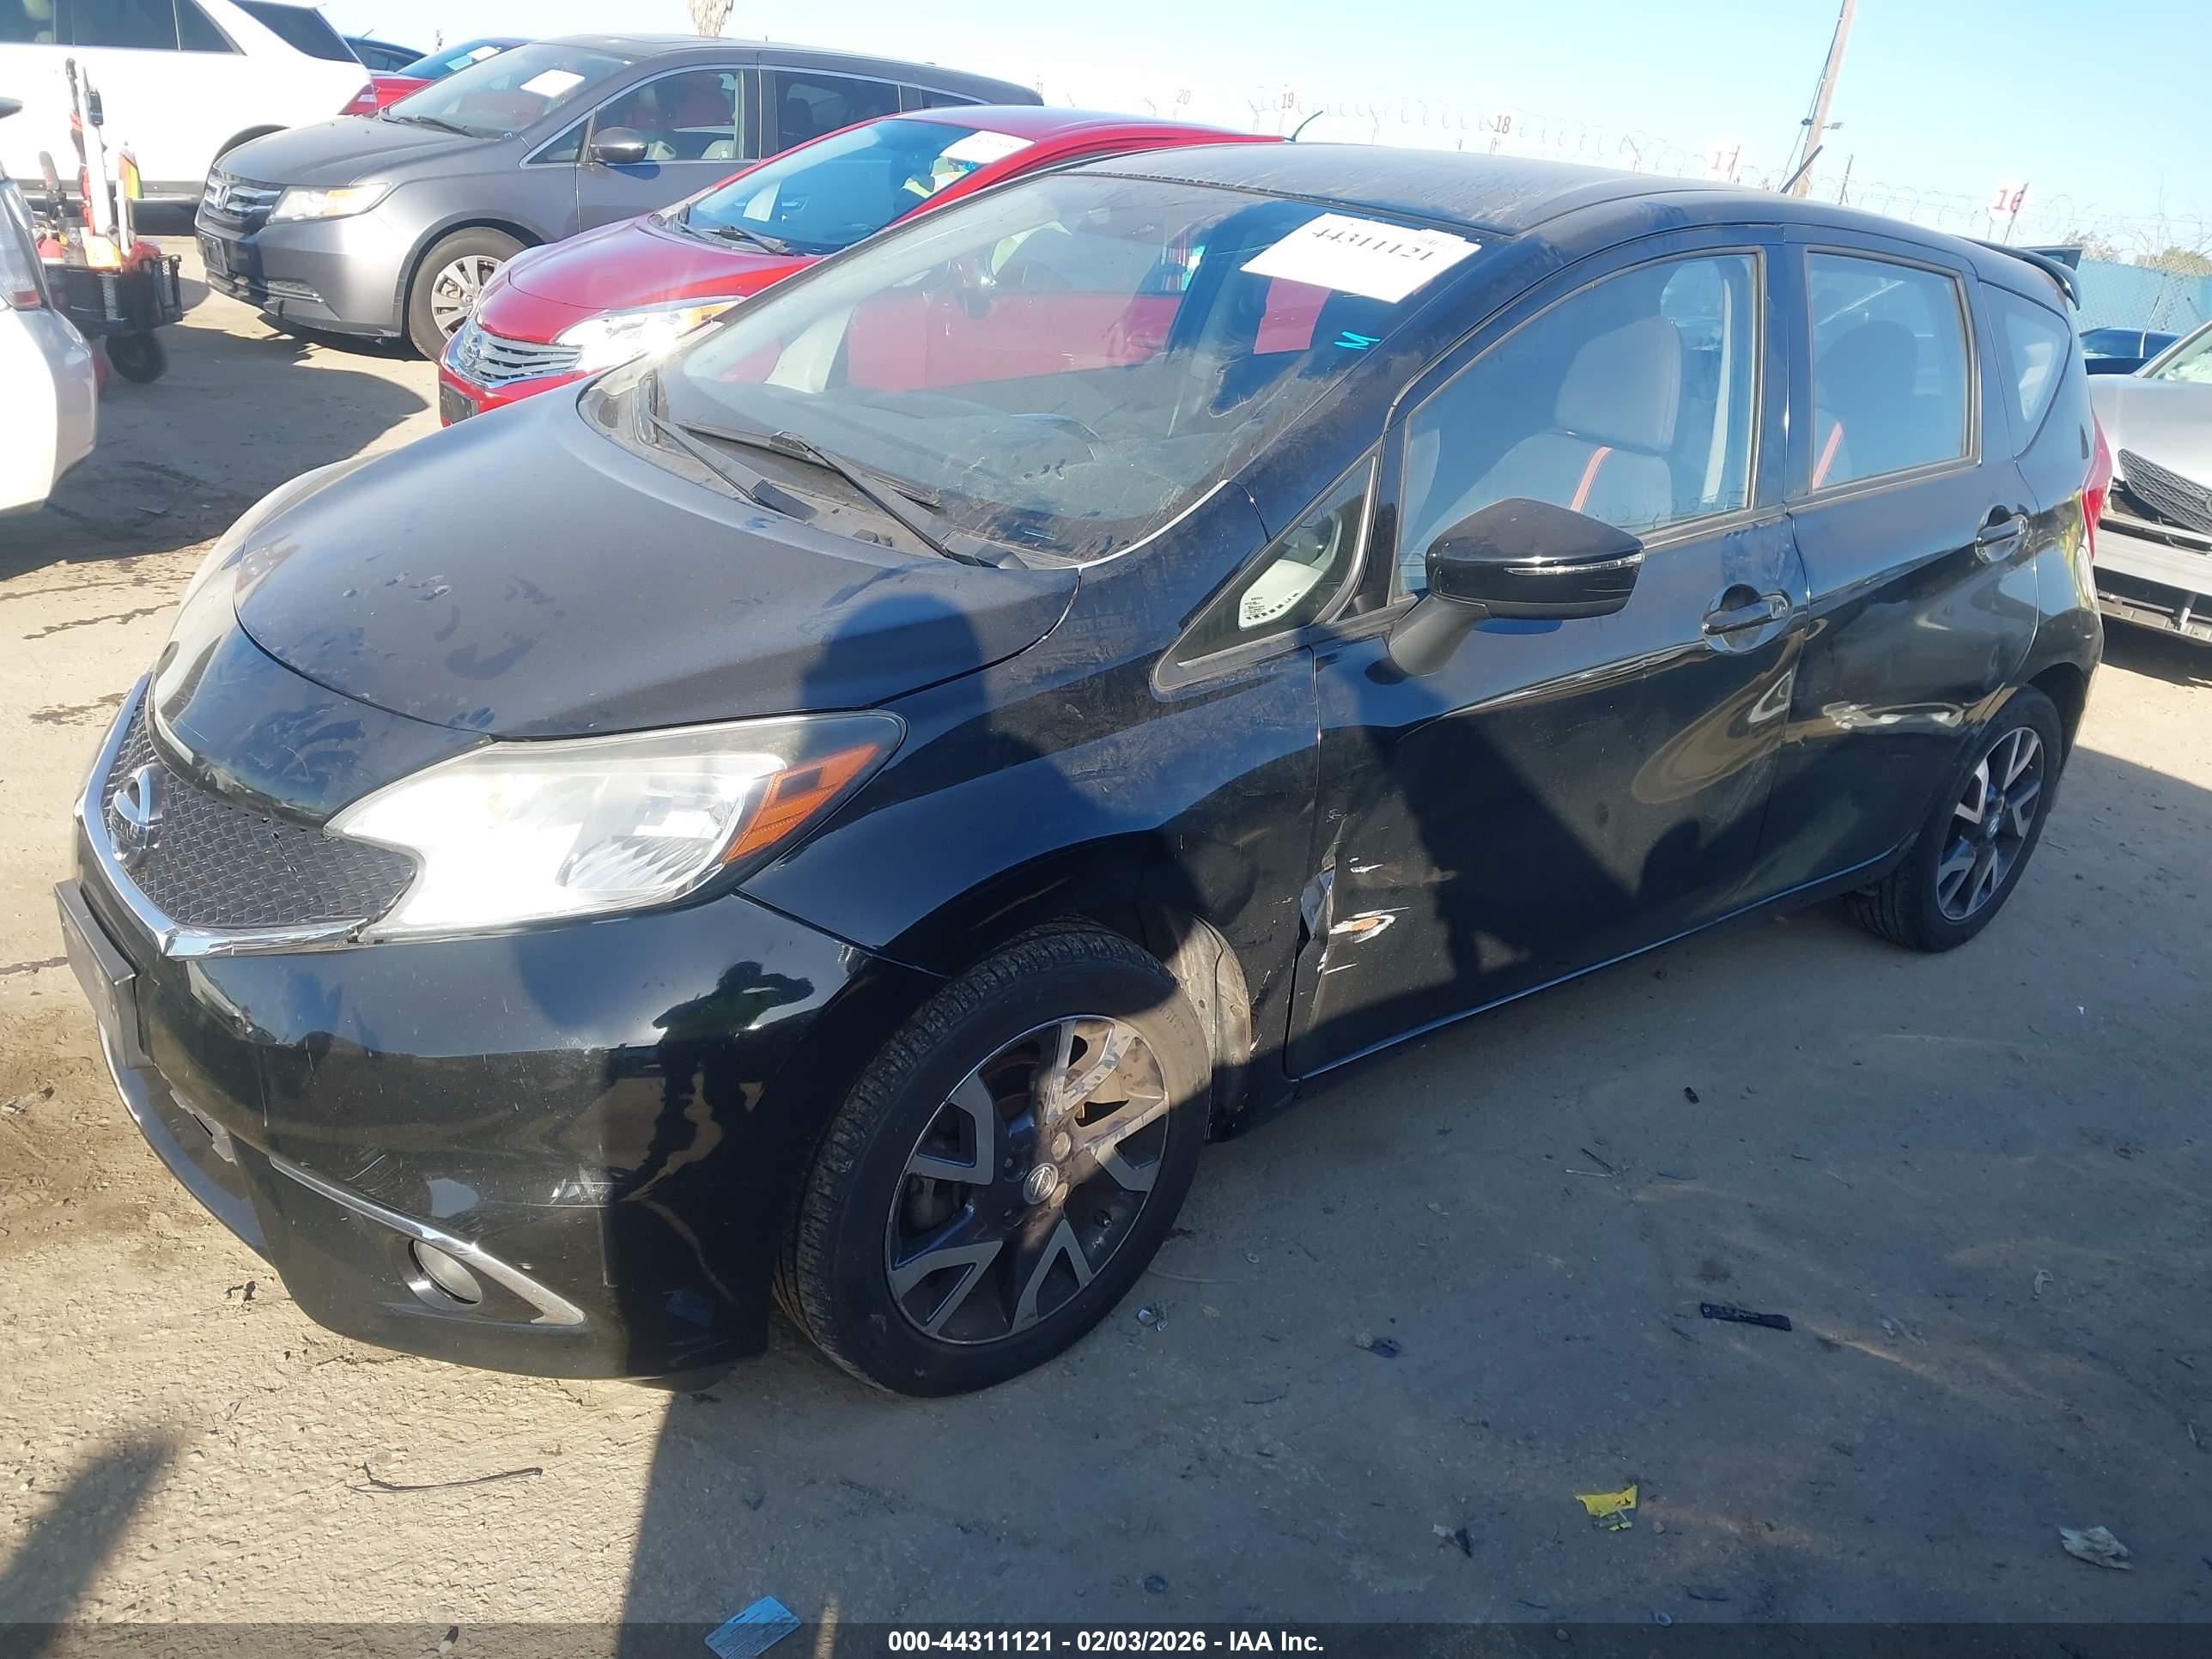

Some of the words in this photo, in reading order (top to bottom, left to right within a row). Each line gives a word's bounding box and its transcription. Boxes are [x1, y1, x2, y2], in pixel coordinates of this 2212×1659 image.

[1176, 88, 1191, 105] 20
[1281, 92, 1295, 109] 19
[1493, 114, 1511, 135] 18
[1711, 150, 1738, 172] 17
